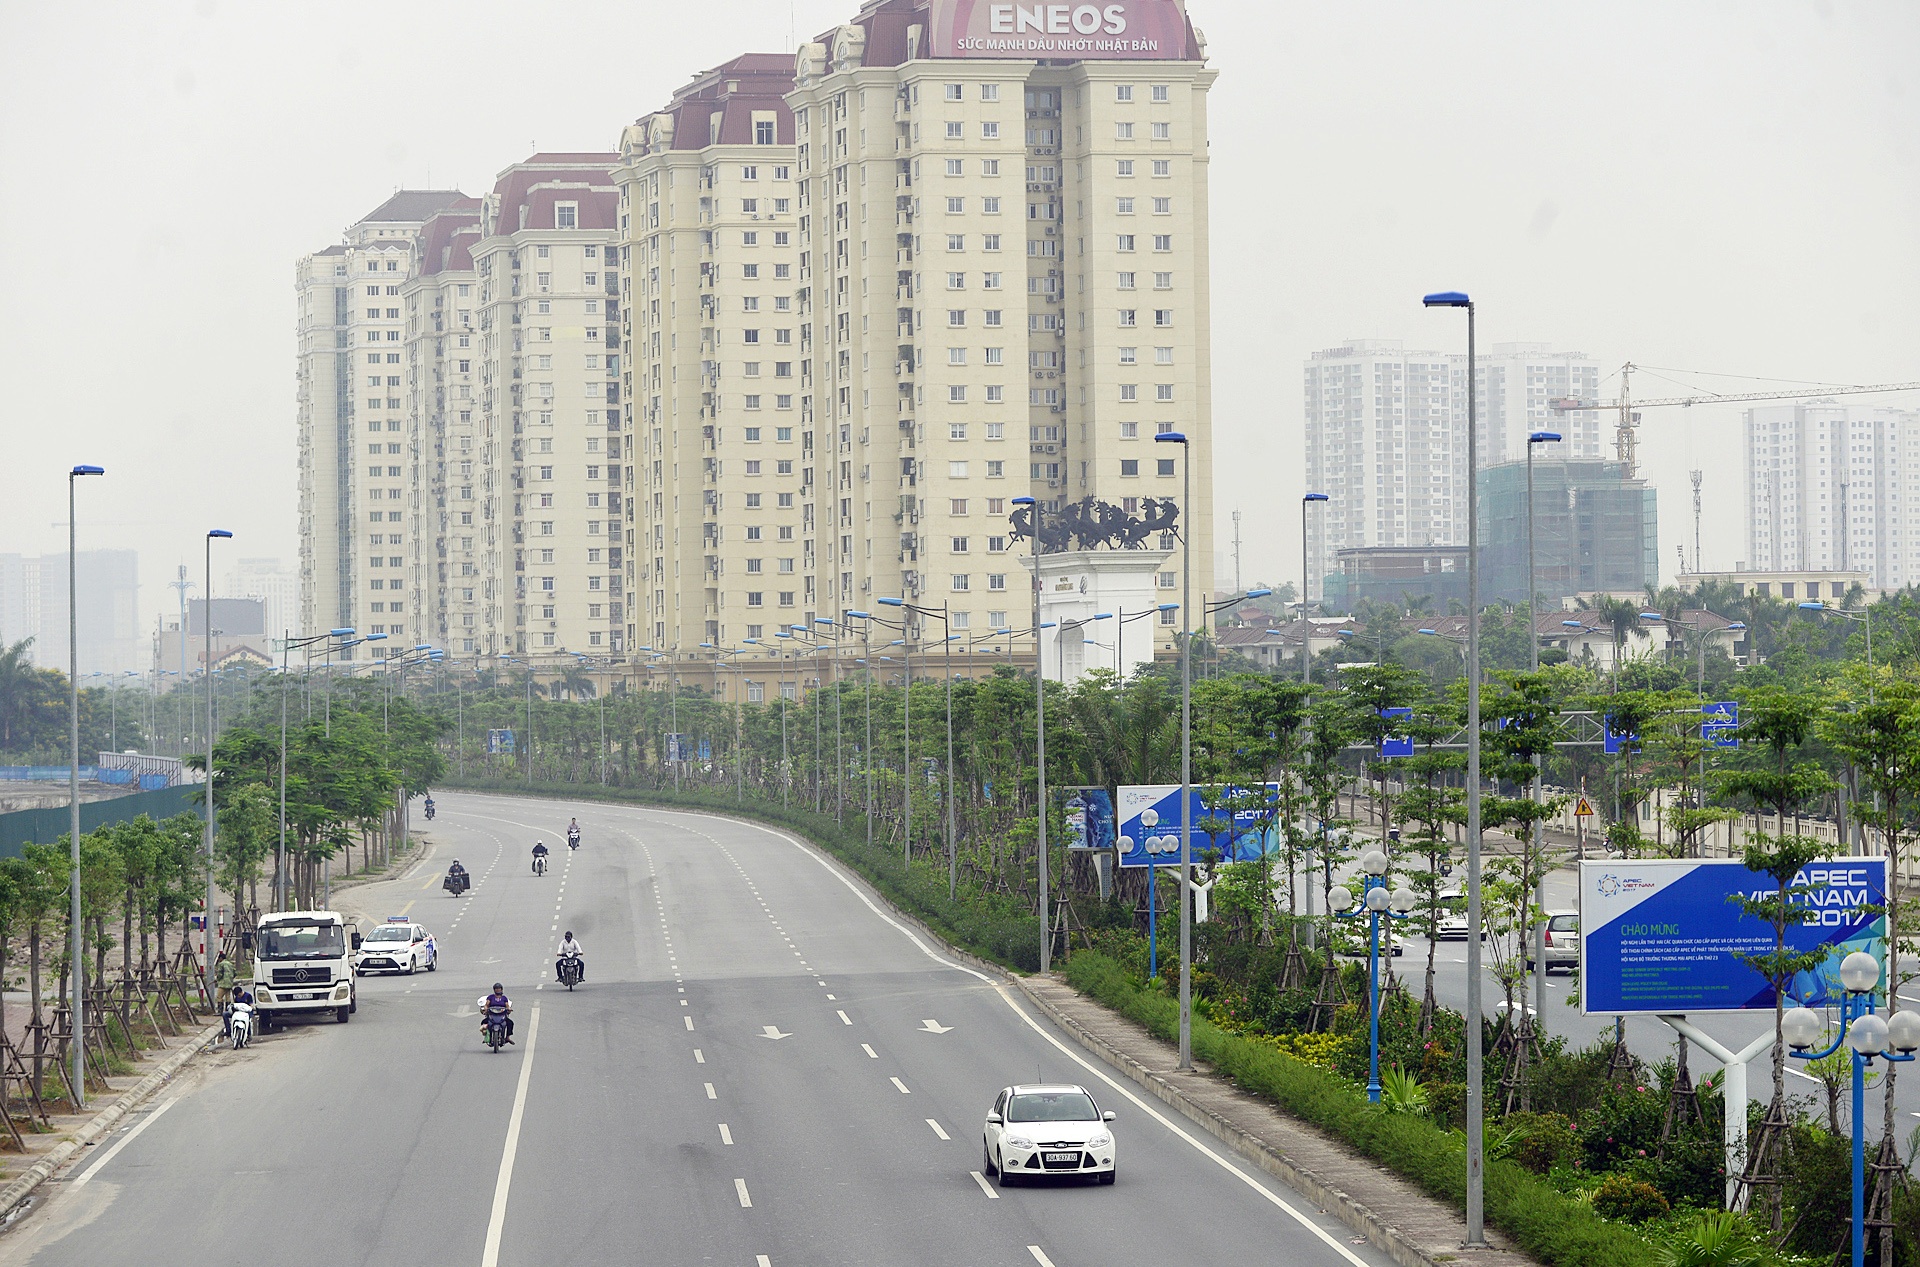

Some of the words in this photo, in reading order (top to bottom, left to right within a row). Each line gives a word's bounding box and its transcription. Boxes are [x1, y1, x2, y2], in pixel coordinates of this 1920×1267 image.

[990, 4, 1126, 34] ENEOS
[958, 37, 983, 50] SỨC
[986, 39, 1024, 53] MẠNH
[1028, 36, 1054, 51] DẦU
[1058, 37, 1092, 51] NHỚT
[1095, 38, 1129, 54] NHẬT
[1132, 37, 1158, 51] BẢN
[1791, 870, 1867, 887] APEC
[1621, 922, 1648, 936] CHÀO
